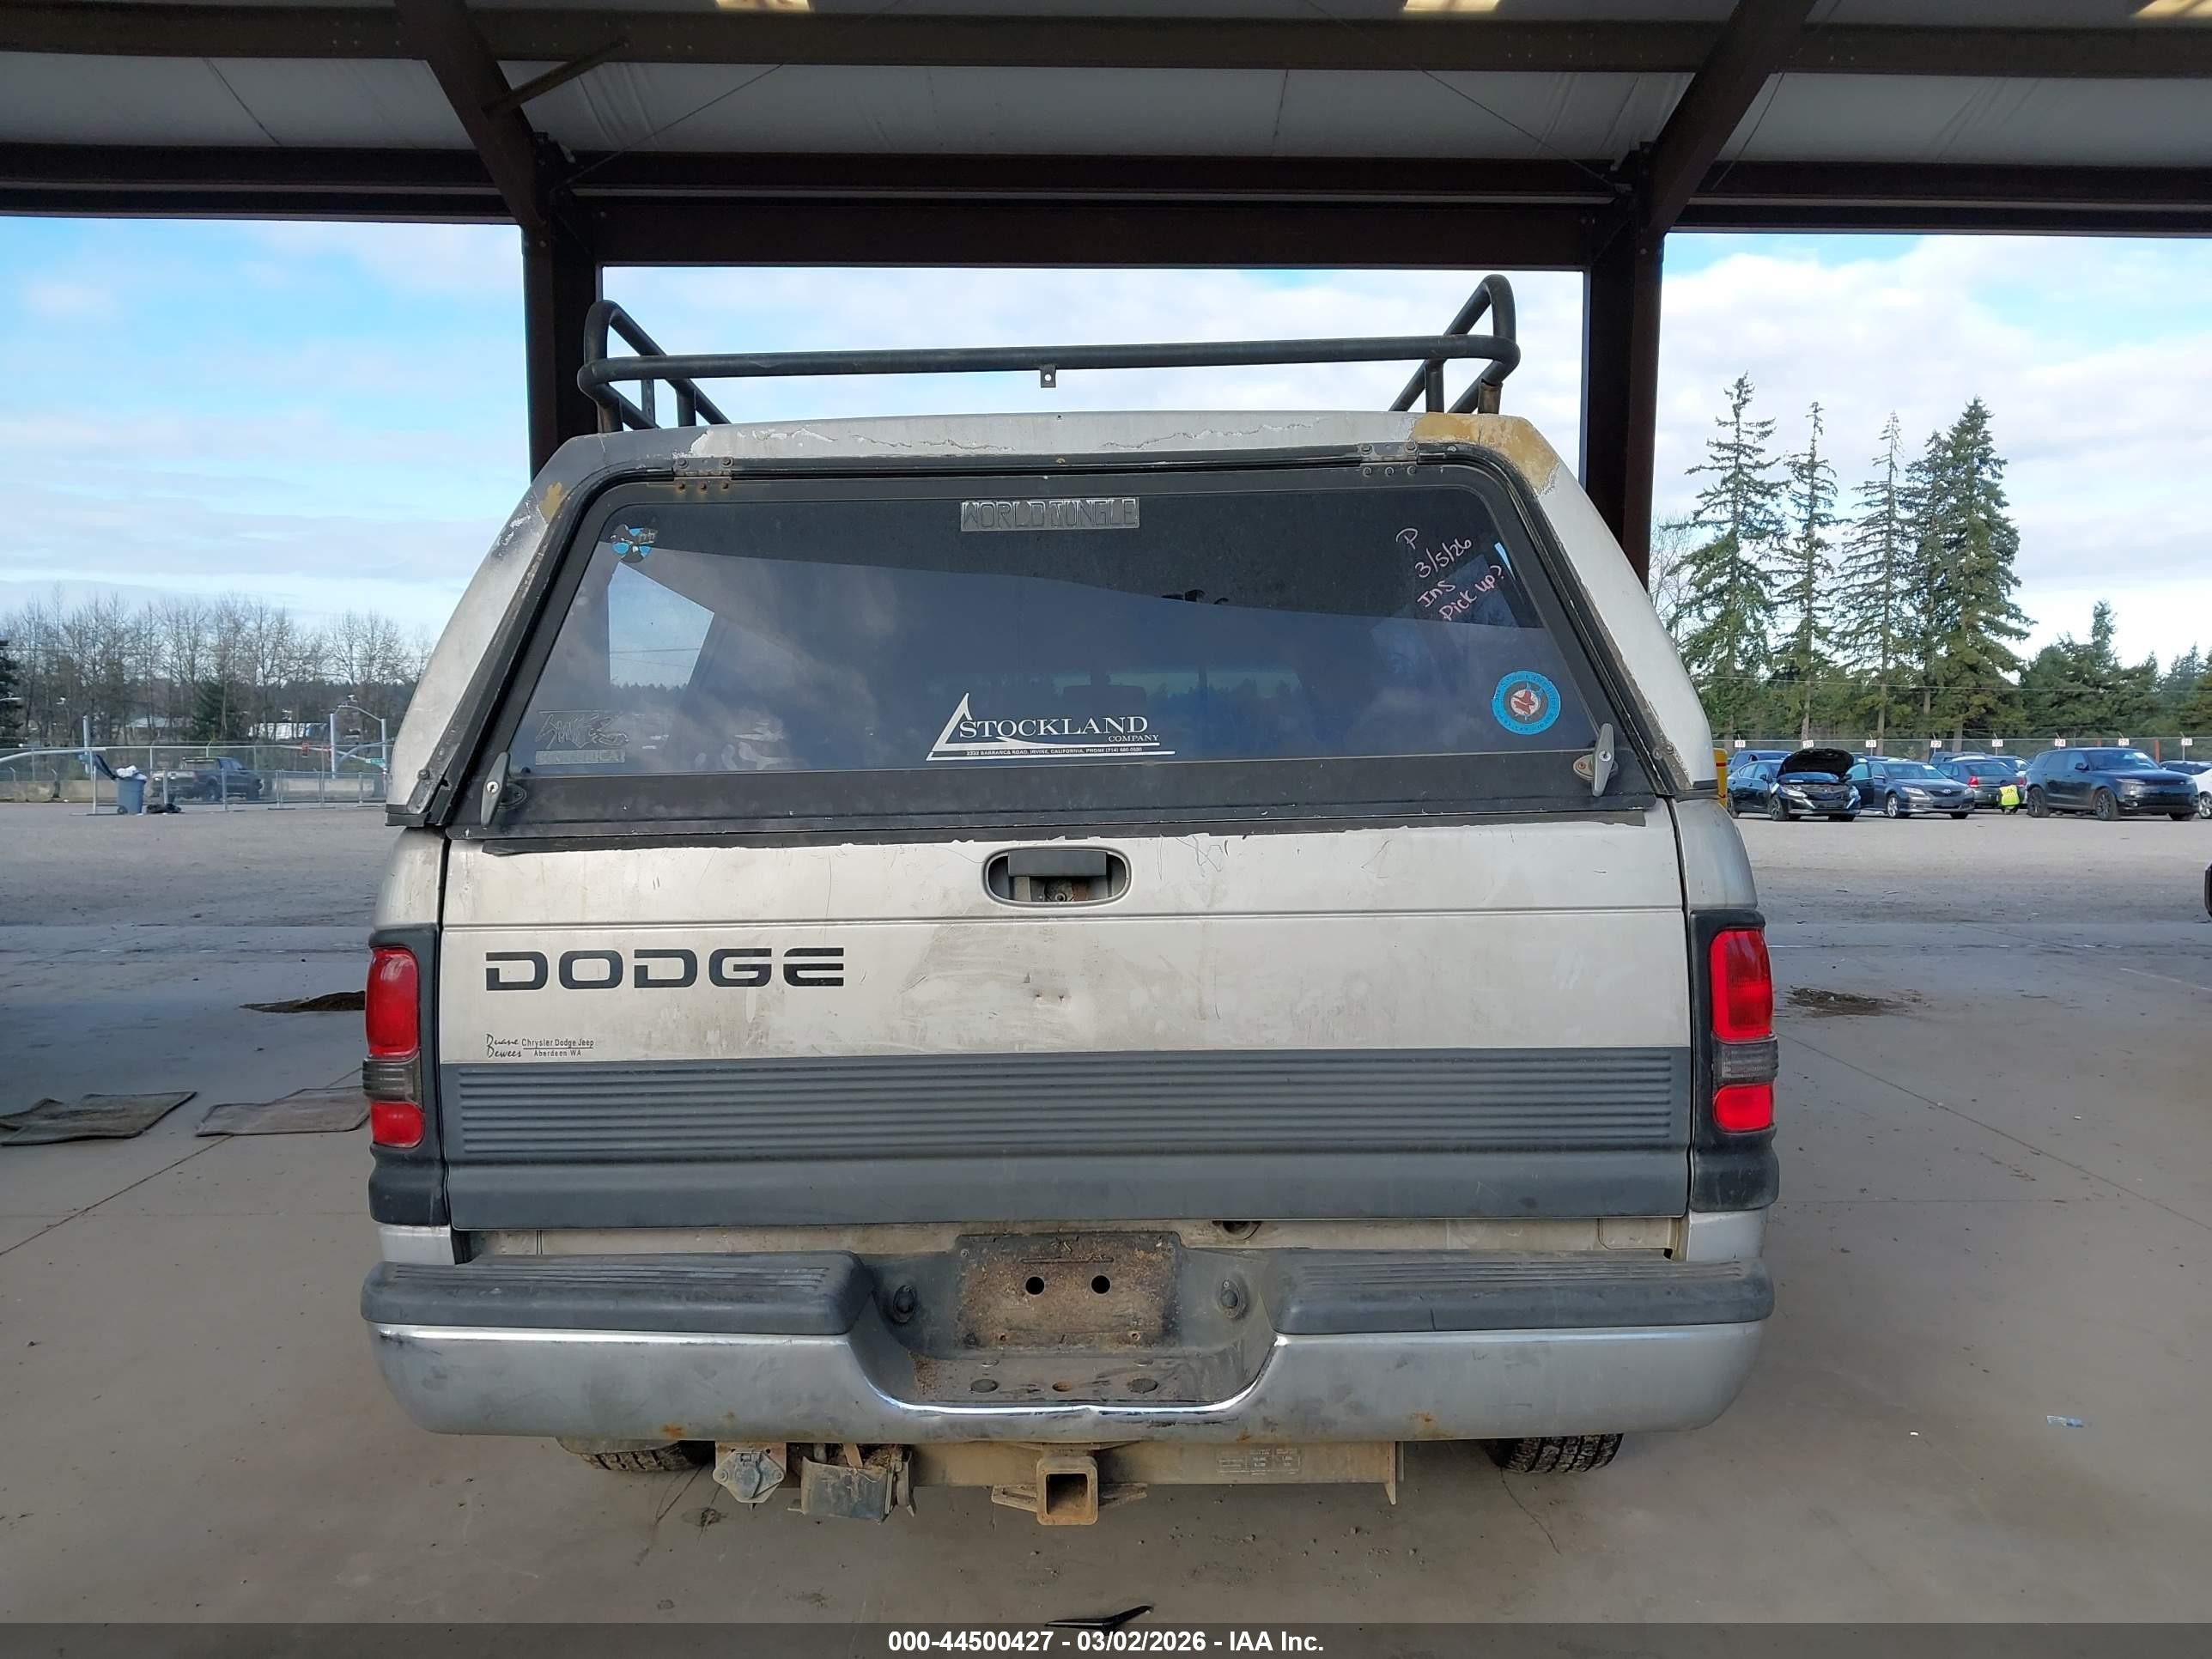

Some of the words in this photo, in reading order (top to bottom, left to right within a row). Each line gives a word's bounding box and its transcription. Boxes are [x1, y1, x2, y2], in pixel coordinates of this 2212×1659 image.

[961, 501, 1046, 528] WORLD
[1414, 538, 1473, 579] 3/5/26
[959, 716, 1148, 738] STOCKLAND
[1108, 734, 1159, 743] COMPANY
[486, 947, 844, 991] DODGE
[521, 1038, 553, 1048] Chrysler
[555, 1038, 576, 1048] Dodge
[577, 1038, 594, 1048] Jeep
